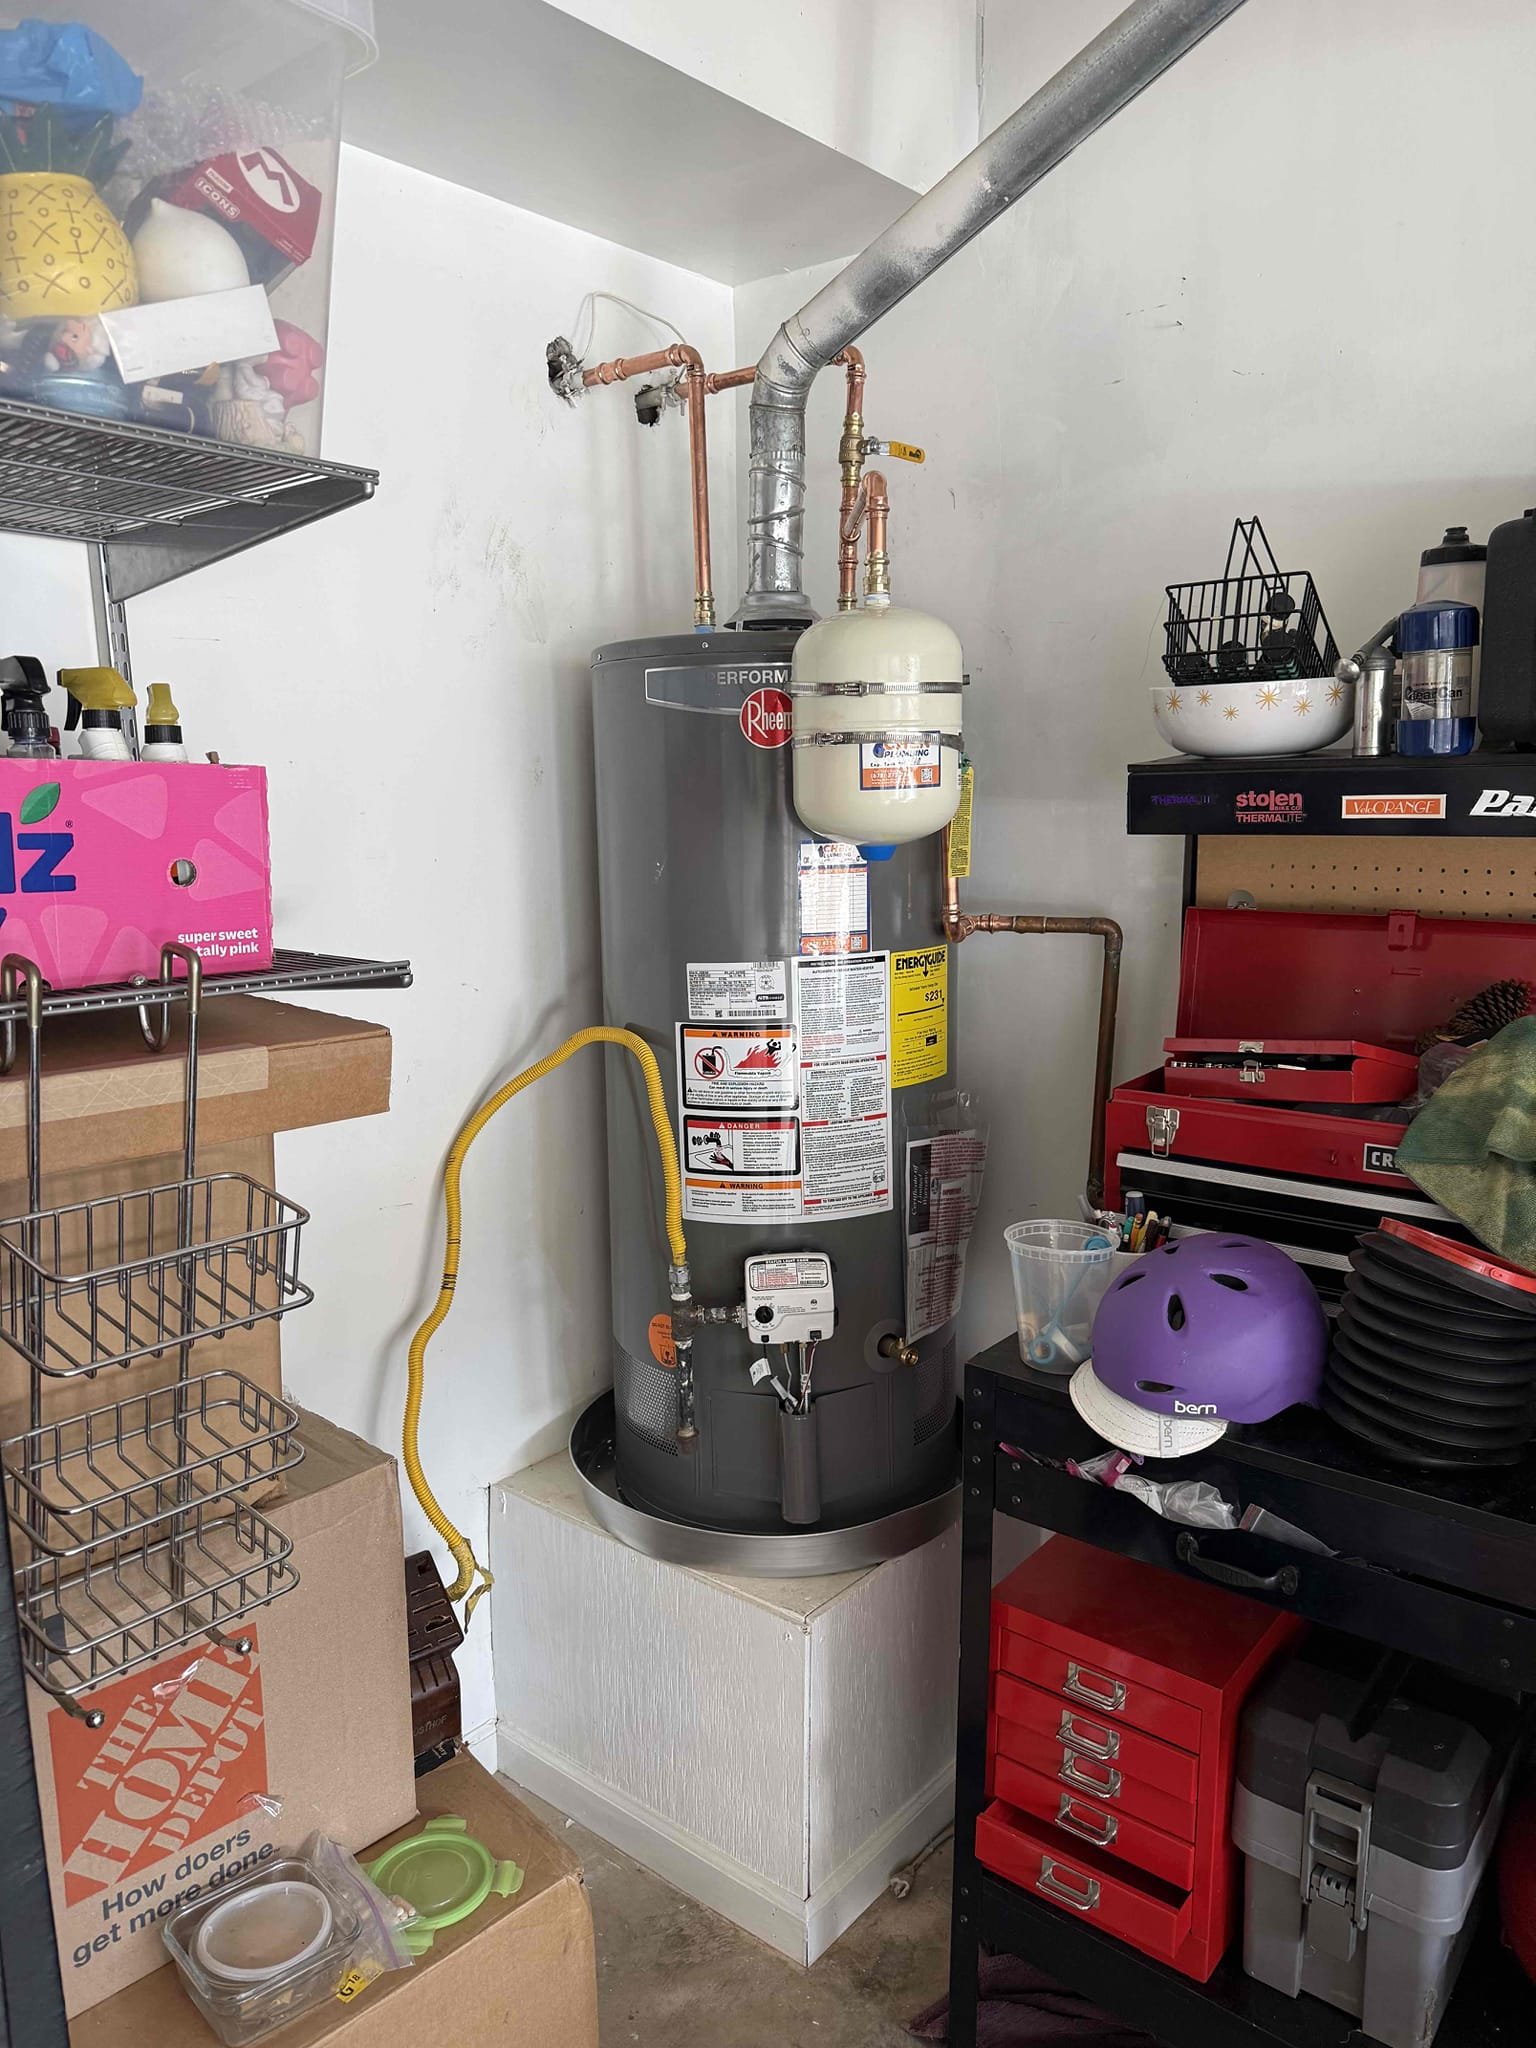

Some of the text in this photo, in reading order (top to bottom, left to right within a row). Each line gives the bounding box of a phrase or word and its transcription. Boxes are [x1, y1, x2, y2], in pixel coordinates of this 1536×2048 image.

[198, 180, 238, 217] ICONS
[705, 669, 792, 685] PERFORM
[748, 691, 792, 738] Rheem
[1236, 791, 1303, 811] stolen
[1469, 789, 1536, 818] Pa
[1236, 814, 1303, 824] THERMALITE
[0, 812, 76, 893] lz
[177, 928, 258, 944] super sweet
[190, 941, 260, 958] tally pink
[895, 950, 946, 972] ENERGYGUIDE
[925, 989, 942, 1002] $231
[1371, 1151, 1397, 1169] CR
[1175, 1400, 1217, 1415] bern
[77, 1694, 164, 1790] THE
[63, 1641, 261, 1887] HOME
[148, 1698, 264, 1852] DEPOT
[101, 1826, 252, 1921] How doers
[72, 1922, 122, 1968] get
[129, 1882, 201, 1934] more
